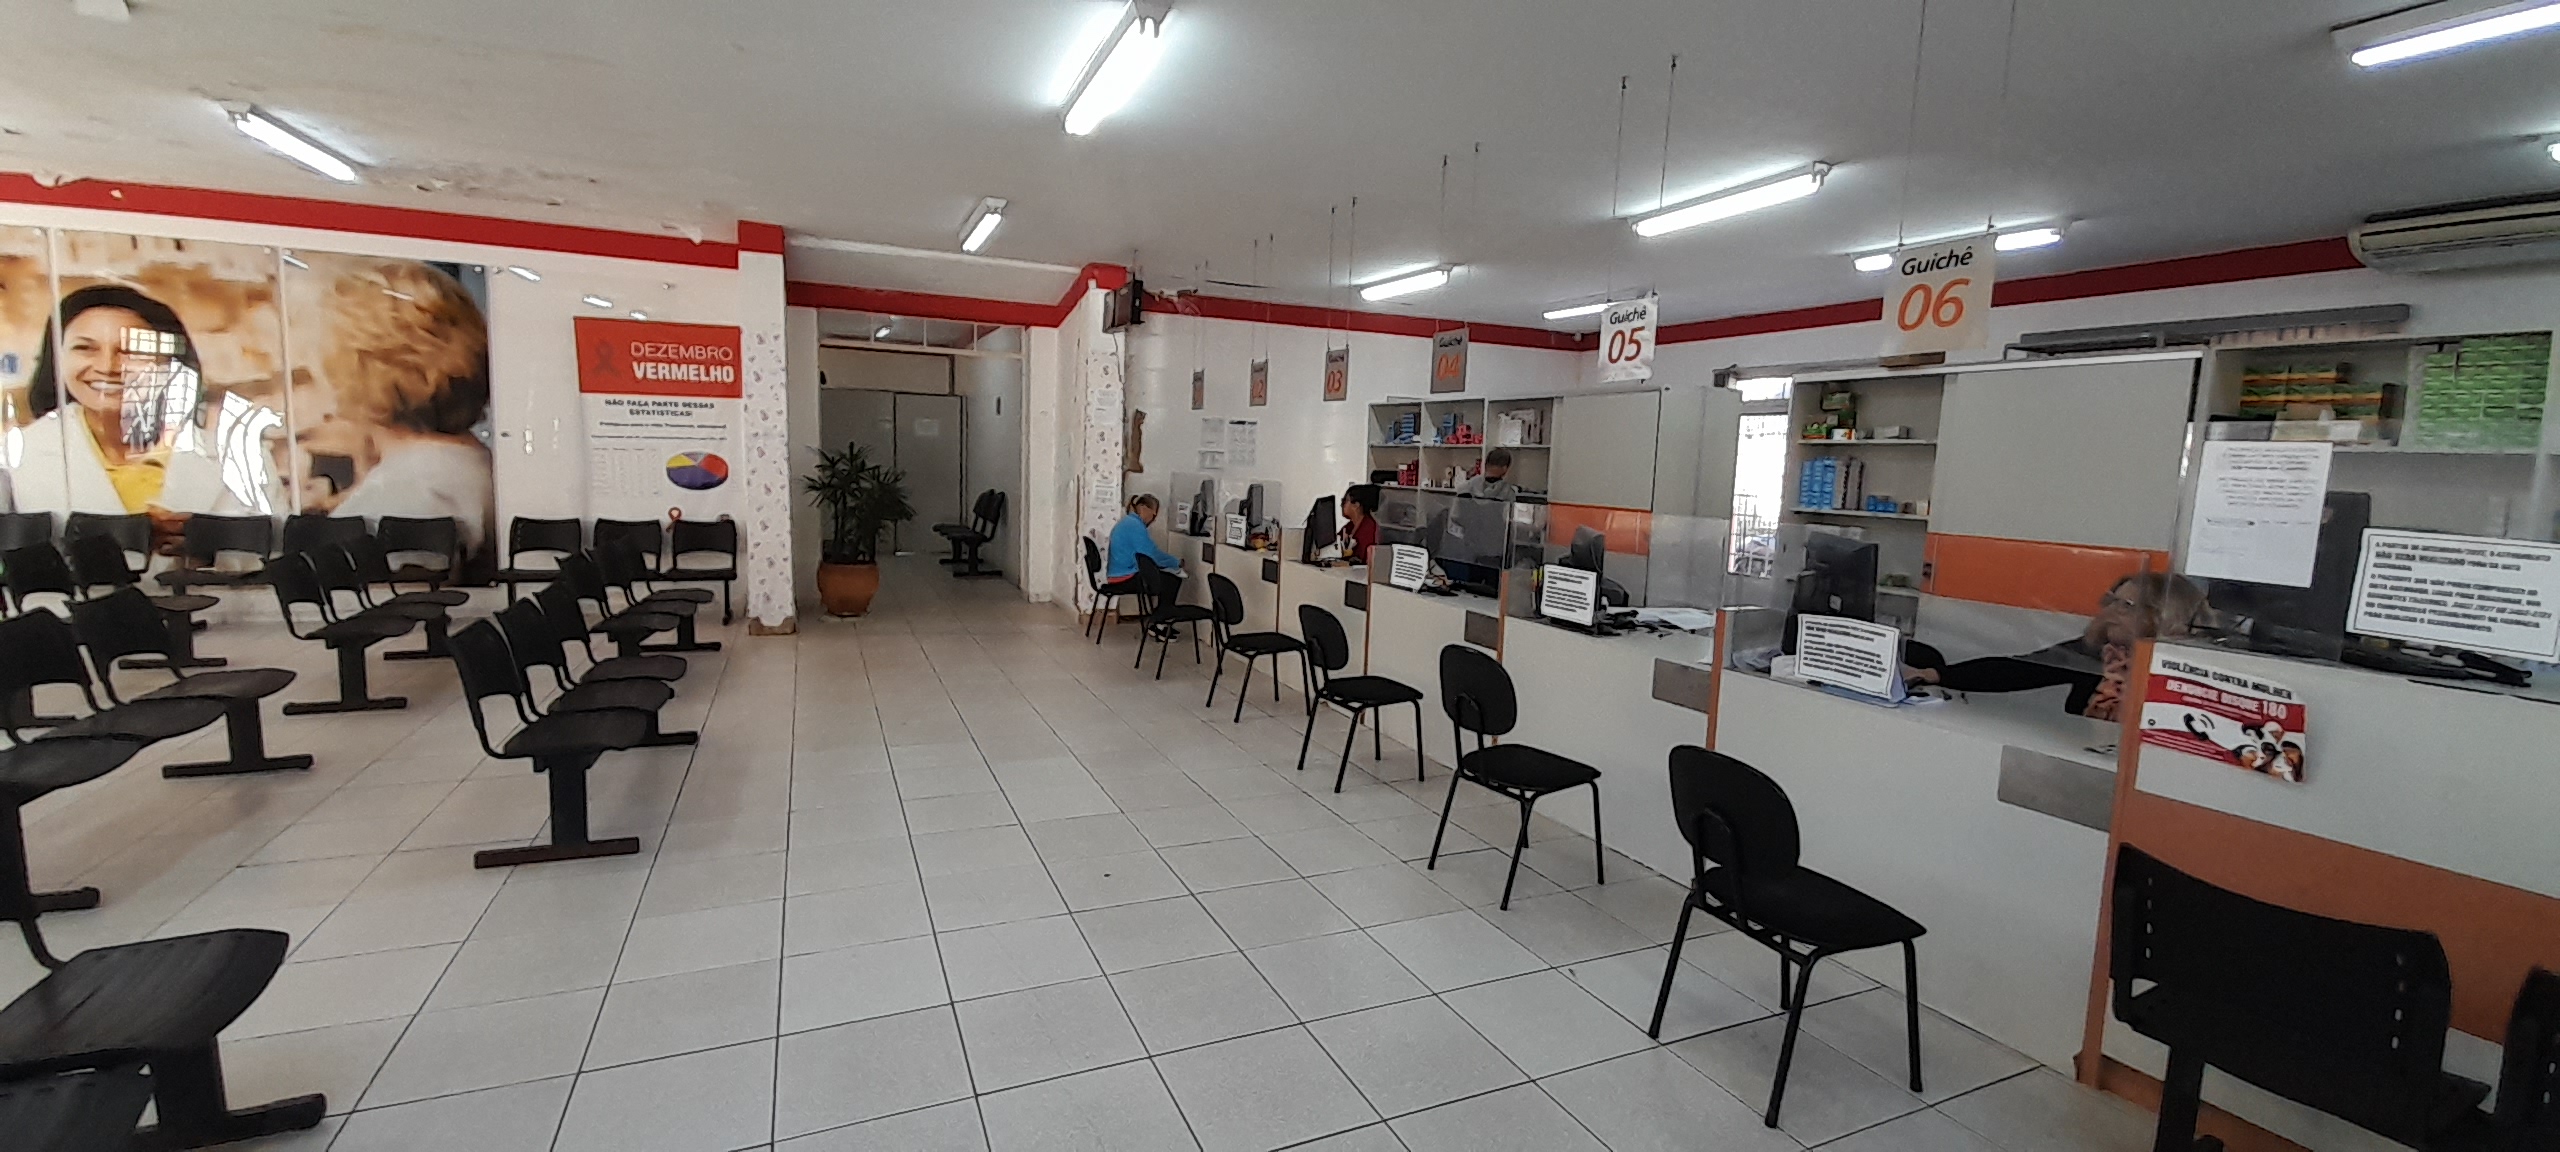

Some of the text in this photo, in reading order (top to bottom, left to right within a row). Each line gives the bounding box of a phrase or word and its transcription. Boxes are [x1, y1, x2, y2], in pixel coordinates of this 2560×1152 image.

[1901, 246, 1973, 276] Guichê
[1609, 305, 1647, 325] Guichê
[1897, 278, 1971, 332] 06
[630, 341, 733, 361] DEZEMBRO
[1608, 326, 1645, 364] 05
[632, 361, 735, 383] VERMELHO
[1437, 353, 1461, 381] 04
[1327, 369, 1343, 394] 03
[2262, 700, 2288, 720] 180
